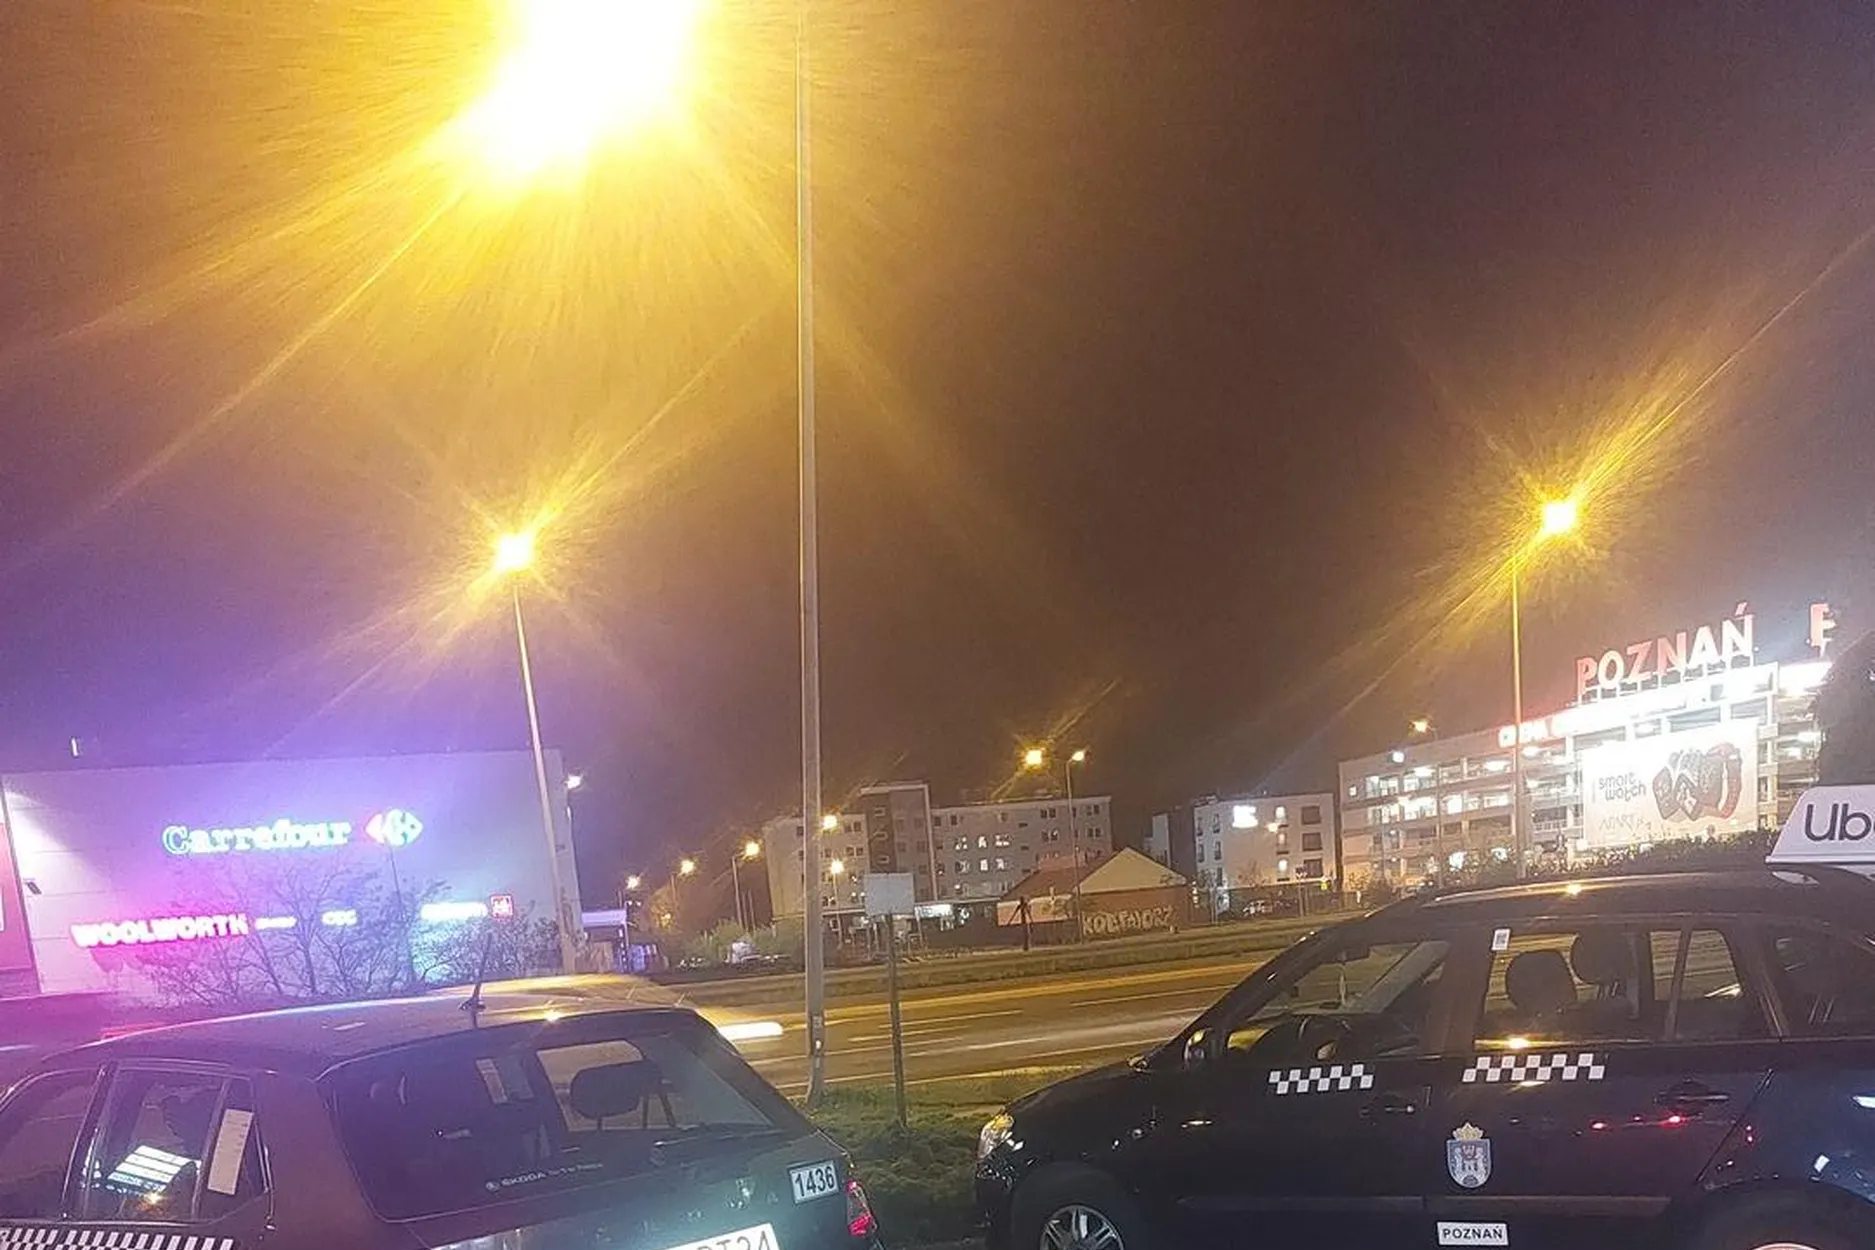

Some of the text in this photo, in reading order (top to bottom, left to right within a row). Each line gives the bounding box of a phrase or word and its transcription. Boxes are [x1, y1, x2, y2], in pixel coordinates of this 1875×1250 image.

[1576, 602, 1754, 692] POZNAŃ
[1599, 772, 1636, 790] smart
[1605, 779, 1646, 801] watch
[163, 818, 351, 855] Carrefour
[1805, 803, 1875, 841] Ub
[71, 912, 248, 948] WOOLWORTH
[795, 1165, 835, 1197] 1436
[1442, 1225, 1503, 1240] POZNAŃ
